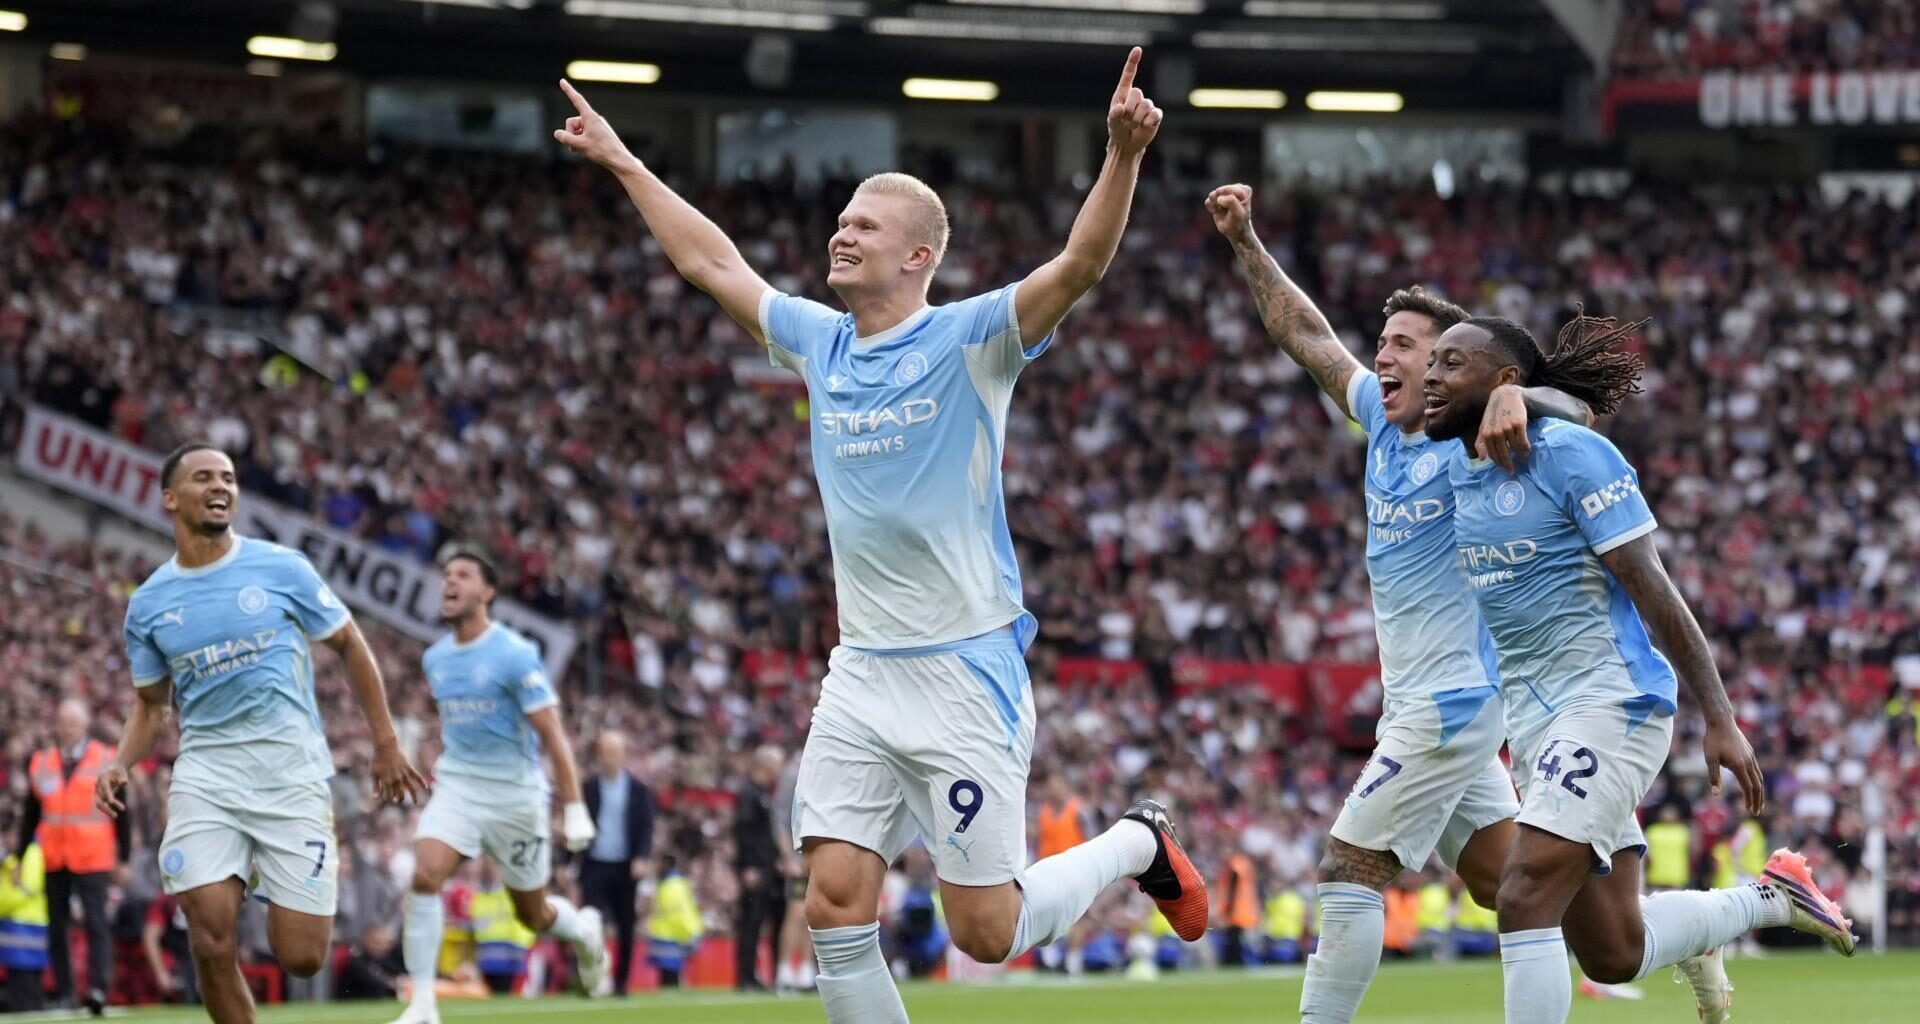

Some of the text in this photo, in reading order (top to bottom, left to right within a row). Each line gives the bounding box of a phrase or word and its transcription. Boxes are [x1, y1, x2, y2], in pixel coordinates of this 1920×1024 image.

[1700, 70, 1797, 127] ONE
[820, 398, 938, 435] ETIHAD
[835, 435, 905, 459] AIRWAYS
[36, 419, 175, 520] UNIT
[1365, 492, 1443, 524] TIHAD
[1457, 539, 1537, 568] TIHAD
[1537, 739, 1598, 800] 42
[948, 779, 984, 833] 9
[304, 840, 326, 878] 7
[511, 836, 544, 867] 27
